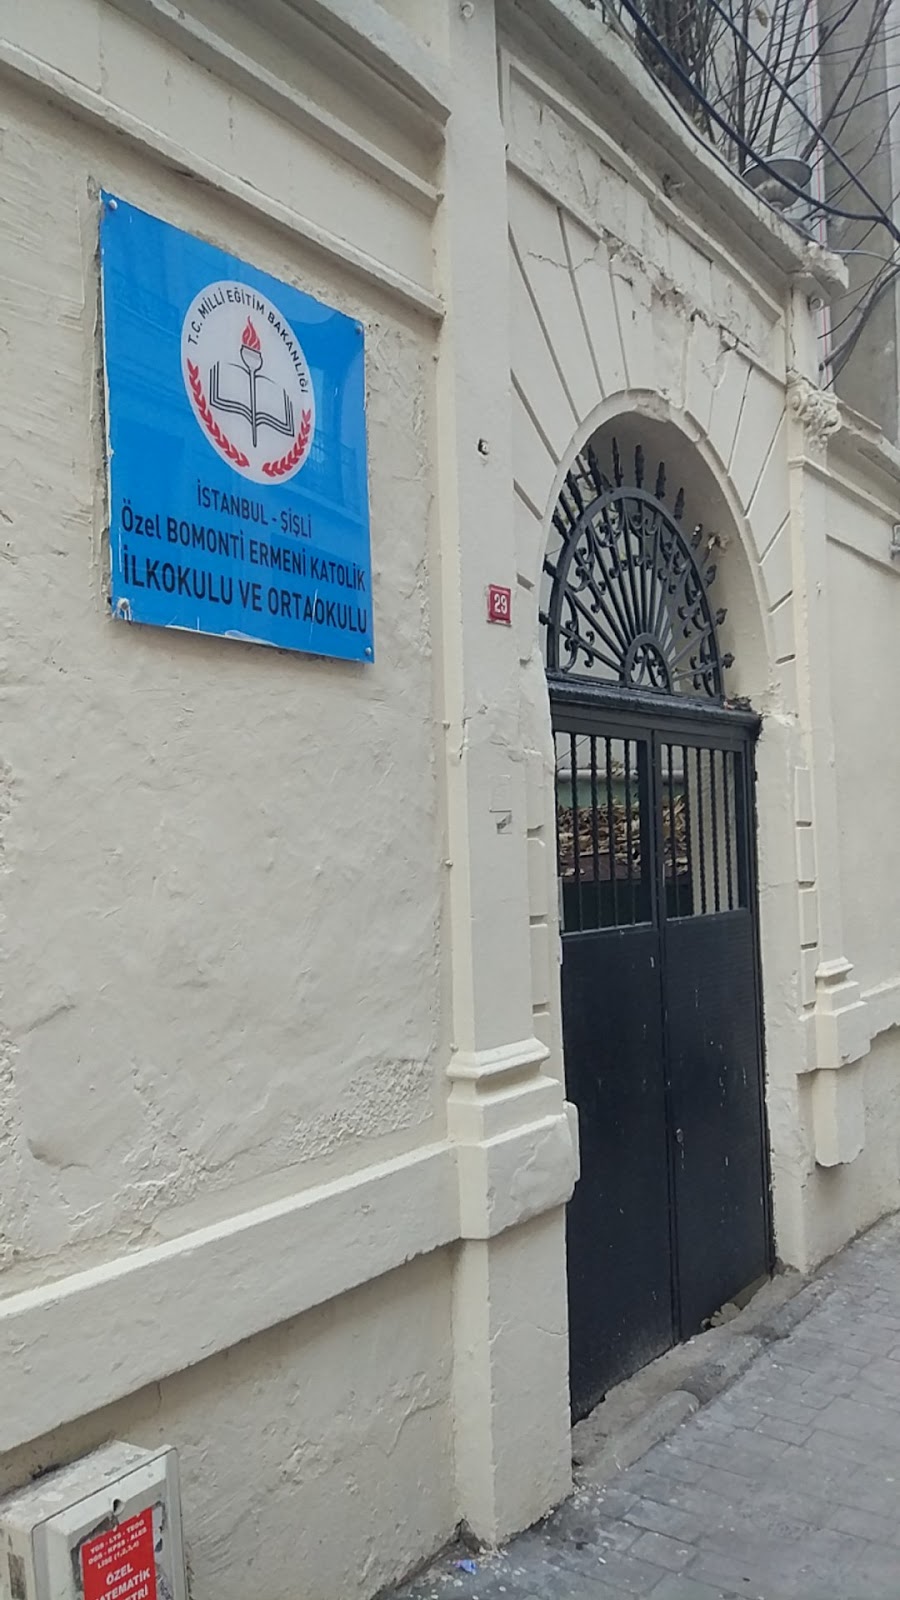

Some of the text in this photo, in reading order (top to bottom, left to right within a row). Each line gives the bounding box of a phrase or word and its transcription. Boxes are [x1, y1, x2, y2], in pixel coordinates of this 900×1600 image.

[197, 287, 226, 320] MİLLİ
[226, 286, 265, 316] EĞİTİM
[267, 311, 309, 394] BAKANLIĞI
[197, 478, 269, 526] İSTANBUL
[280, 507, 312, 539] ŞİŞLİ
[121, 497, 366, 592] Özel BOMONTİ ERMENİ KATOLİK
[123, 544, 367, 634] İLKOKULU VE ORTAOKULU
[494, 593, 508, 615] 29
[95, 1567, 151, 1600] ATEMATİK
[106, 1562, 134, 1586] ÖZEL
